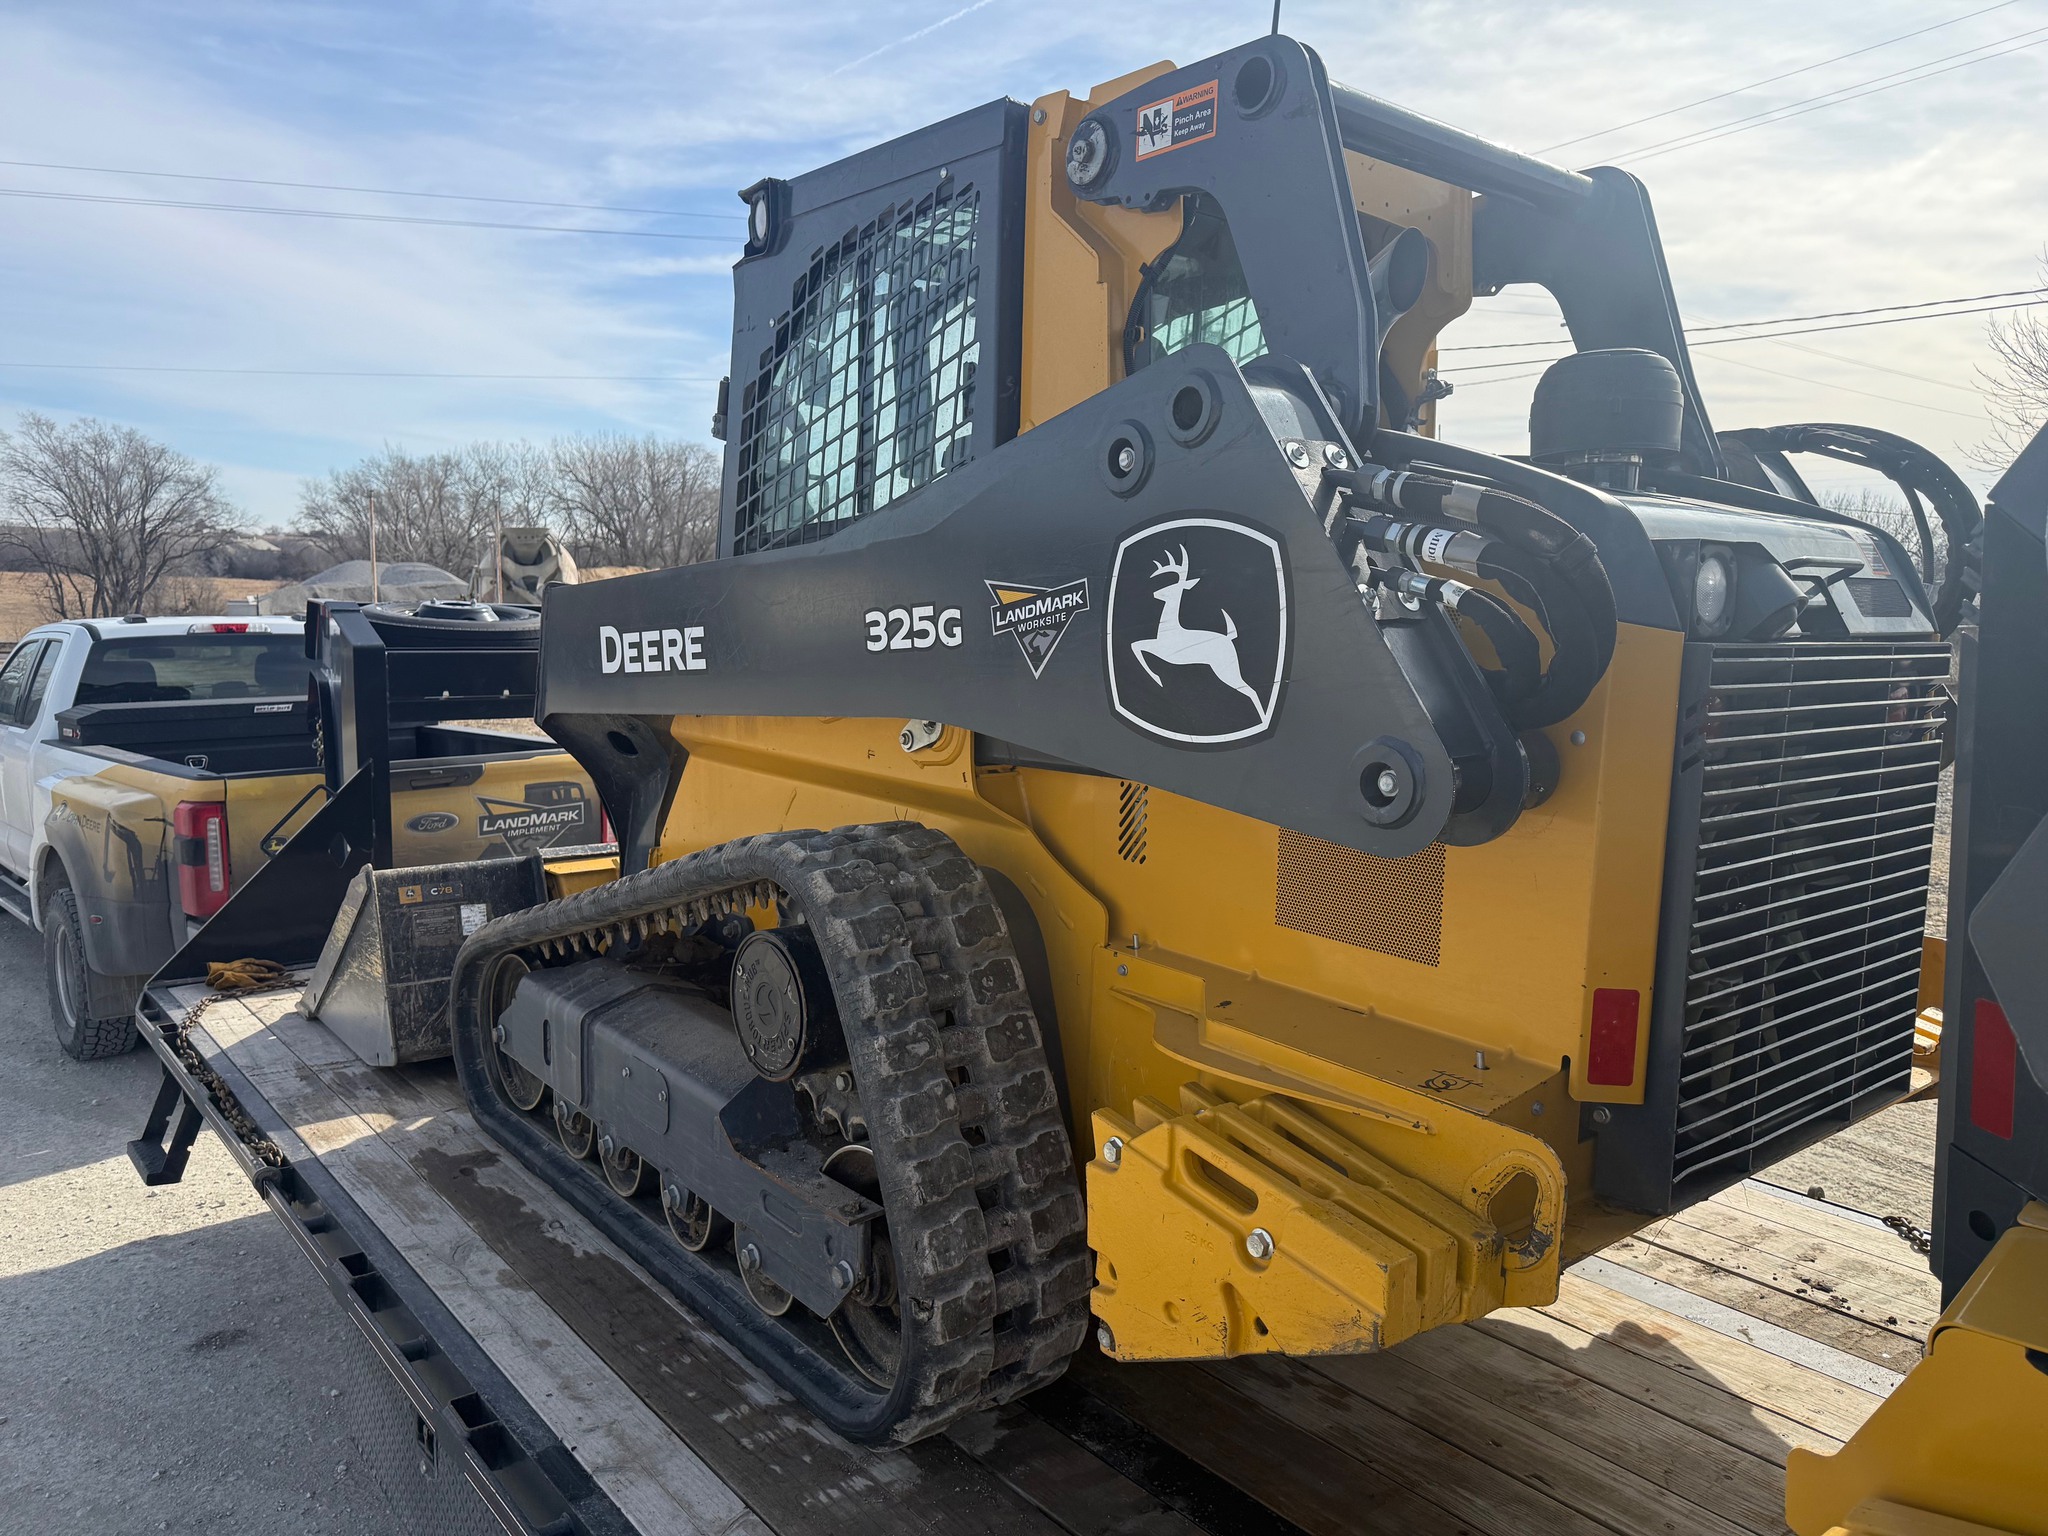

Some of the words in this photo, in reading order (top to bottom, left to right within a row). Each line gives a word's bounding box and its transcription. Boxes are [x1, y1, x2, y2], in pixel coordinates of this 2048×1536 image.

[1182, 86, 1214, 104] WARNING
[1174, 114, 1194, 127] Pinch
[1195, 108, 1212, 119] Area
[1174, 128, 1189, 138] Keep
[1189, 121, 1206, 132] Away
[864, 605, 964, 652] 325G
[1017, 610, 1067, 634] WORKSITE
[599, 625, 708, 675] DEERE
[418, 816, 448, 831] Ford
[507, 823, 561, 837] IMPLEMENT
[763, 1010, 792, 1053] SPICER
